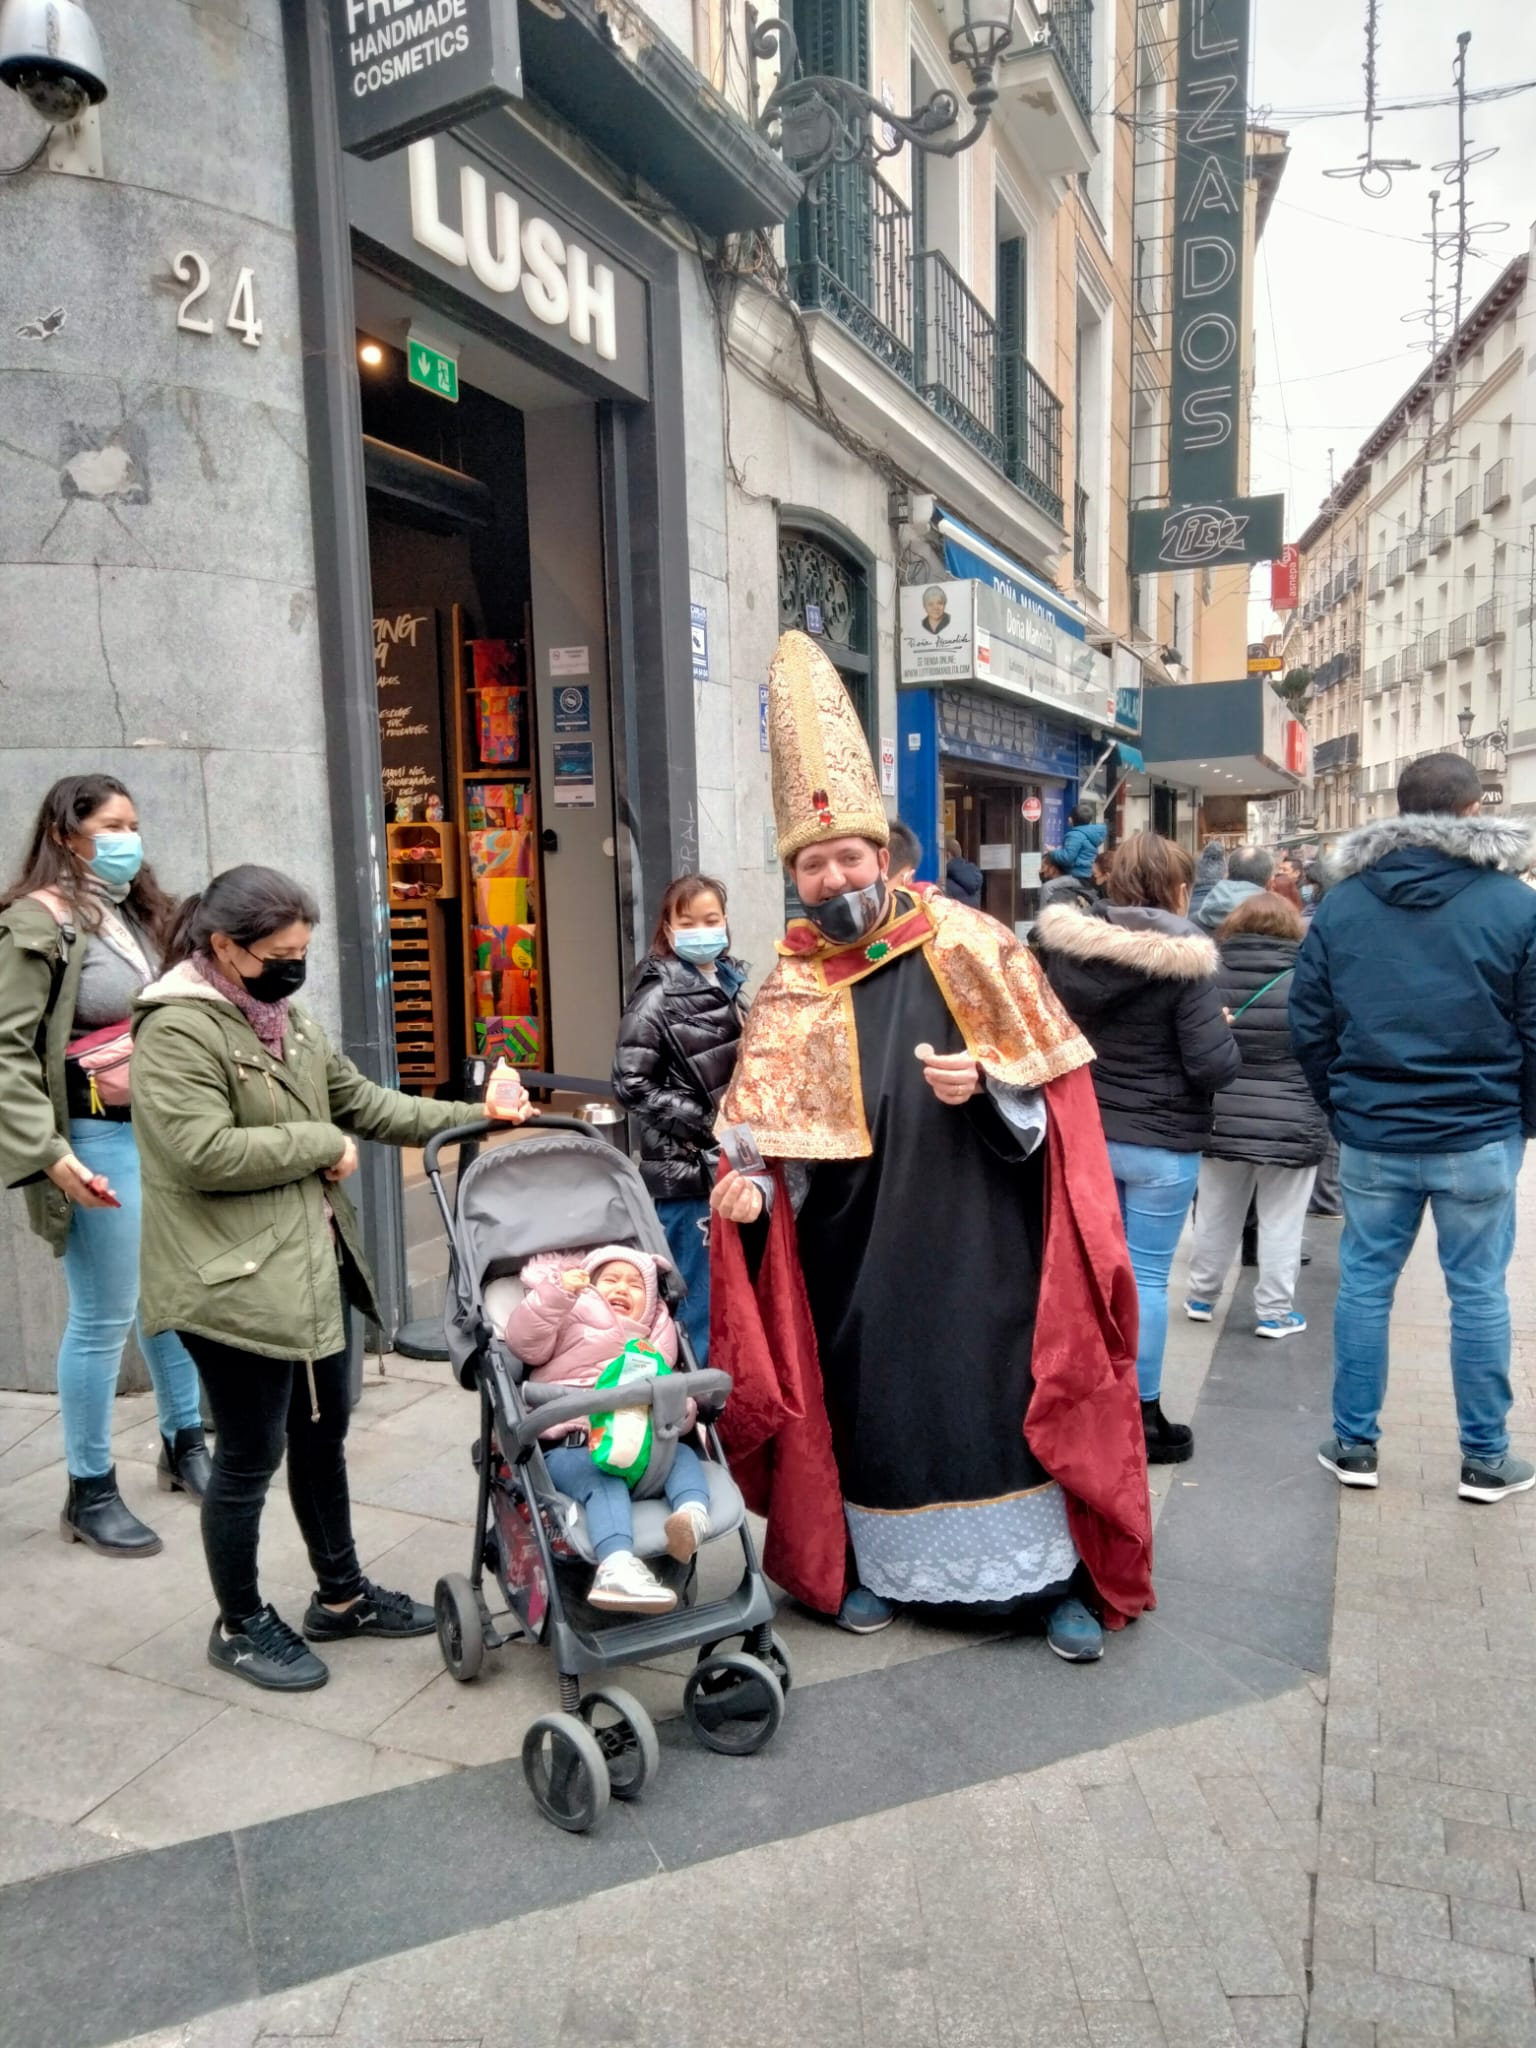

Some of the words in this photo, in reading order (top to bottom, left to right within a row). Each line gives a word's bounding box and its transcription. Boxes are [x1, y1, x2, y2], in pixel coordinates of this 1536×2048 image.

[350, 0, 467, 66] HANDMADE
[354, 24, 469, 97] COSMETICS
[408, 137, 617, 361] LUSH
[173, 250, 263, 348] 24
[993, 576, 1017, 603] DOÑA
[1006, 607, 1025, 640] Doña
[1025, 618, 1053, 654] Manolita
